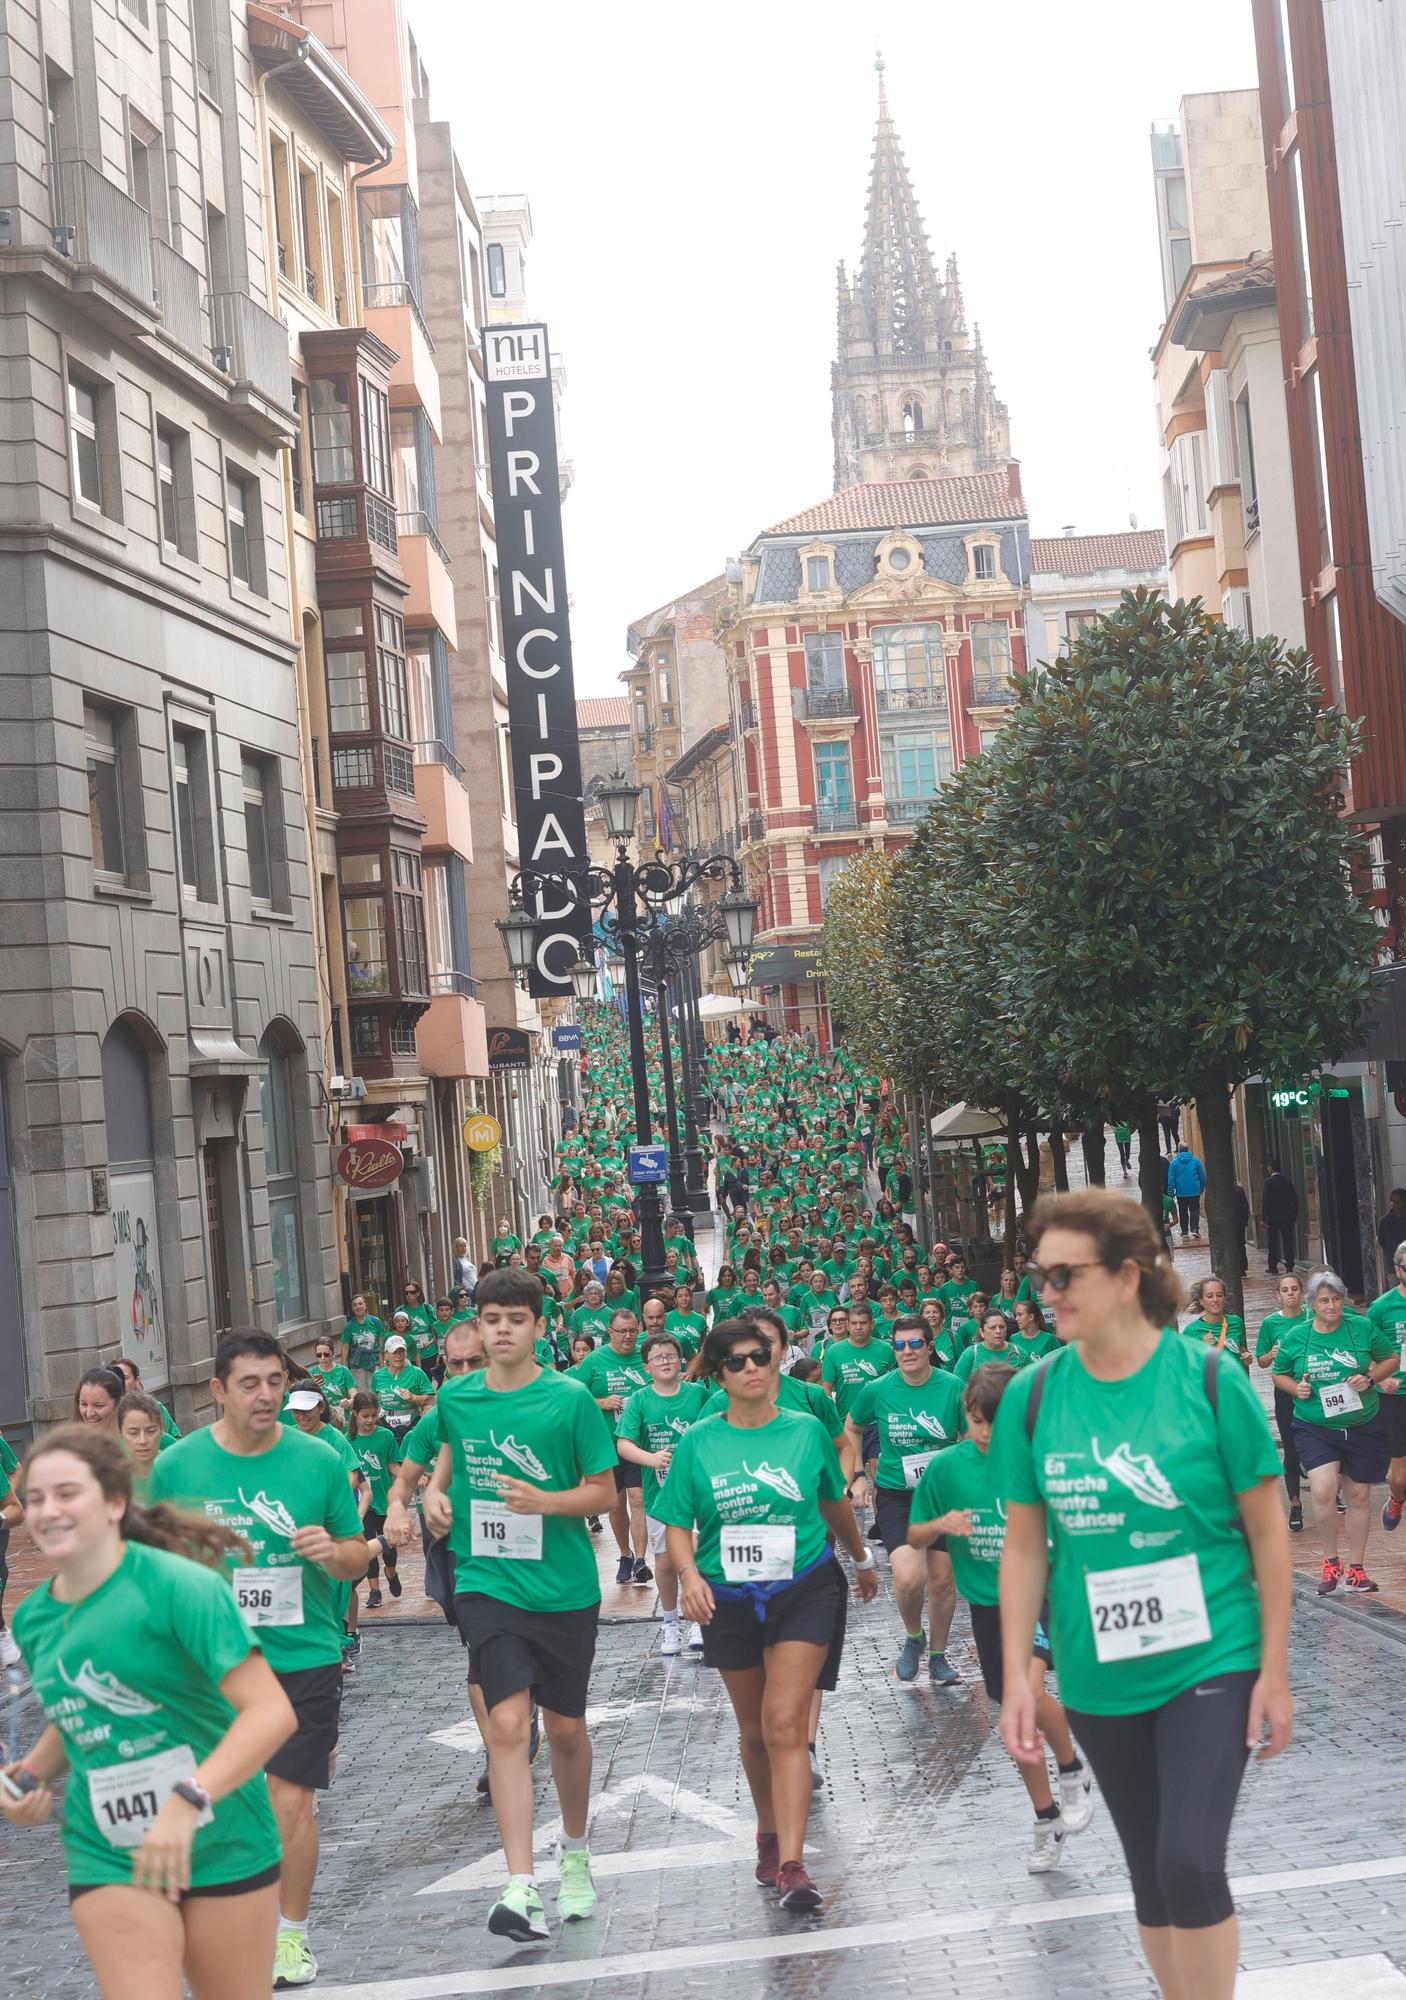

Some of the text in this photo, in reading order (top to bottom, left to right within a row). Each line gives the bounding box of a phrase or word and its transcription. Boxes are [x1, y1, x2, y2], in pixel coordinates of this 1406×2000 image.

[495, 364, 541, 376] HOTELES
[501, 390, 579, 984] PRINCIPADO
[558, 1033, 579, 1042] BBVA
[345, 1151, 397, 1180] Rialto
[1326, 1394, 1344, 1408] 594
[465, 1454, 503, 1466] marcha
[1044, 1459, 1066, 1476] En
[711, 1477, 727, 1489] En
[1045, 1475, 1108, 1494] marcha
[713, 1483, 758, 1501] marcha
[205, 1504, 222, 1516] En
[716, 1496, 753, 1511] contra
[731, 1504, 770, 1519] cáncer
[482, 1520, 506, 1540] 113
[968, 1537, 1004, 1547] contra
[728, 1545, 762, 1563] 1115
[238, 1589, 272, 1608] 536
[1096, 1597, 1163, 1632] 2328
[102, 1790, 158, 1826] 1447
